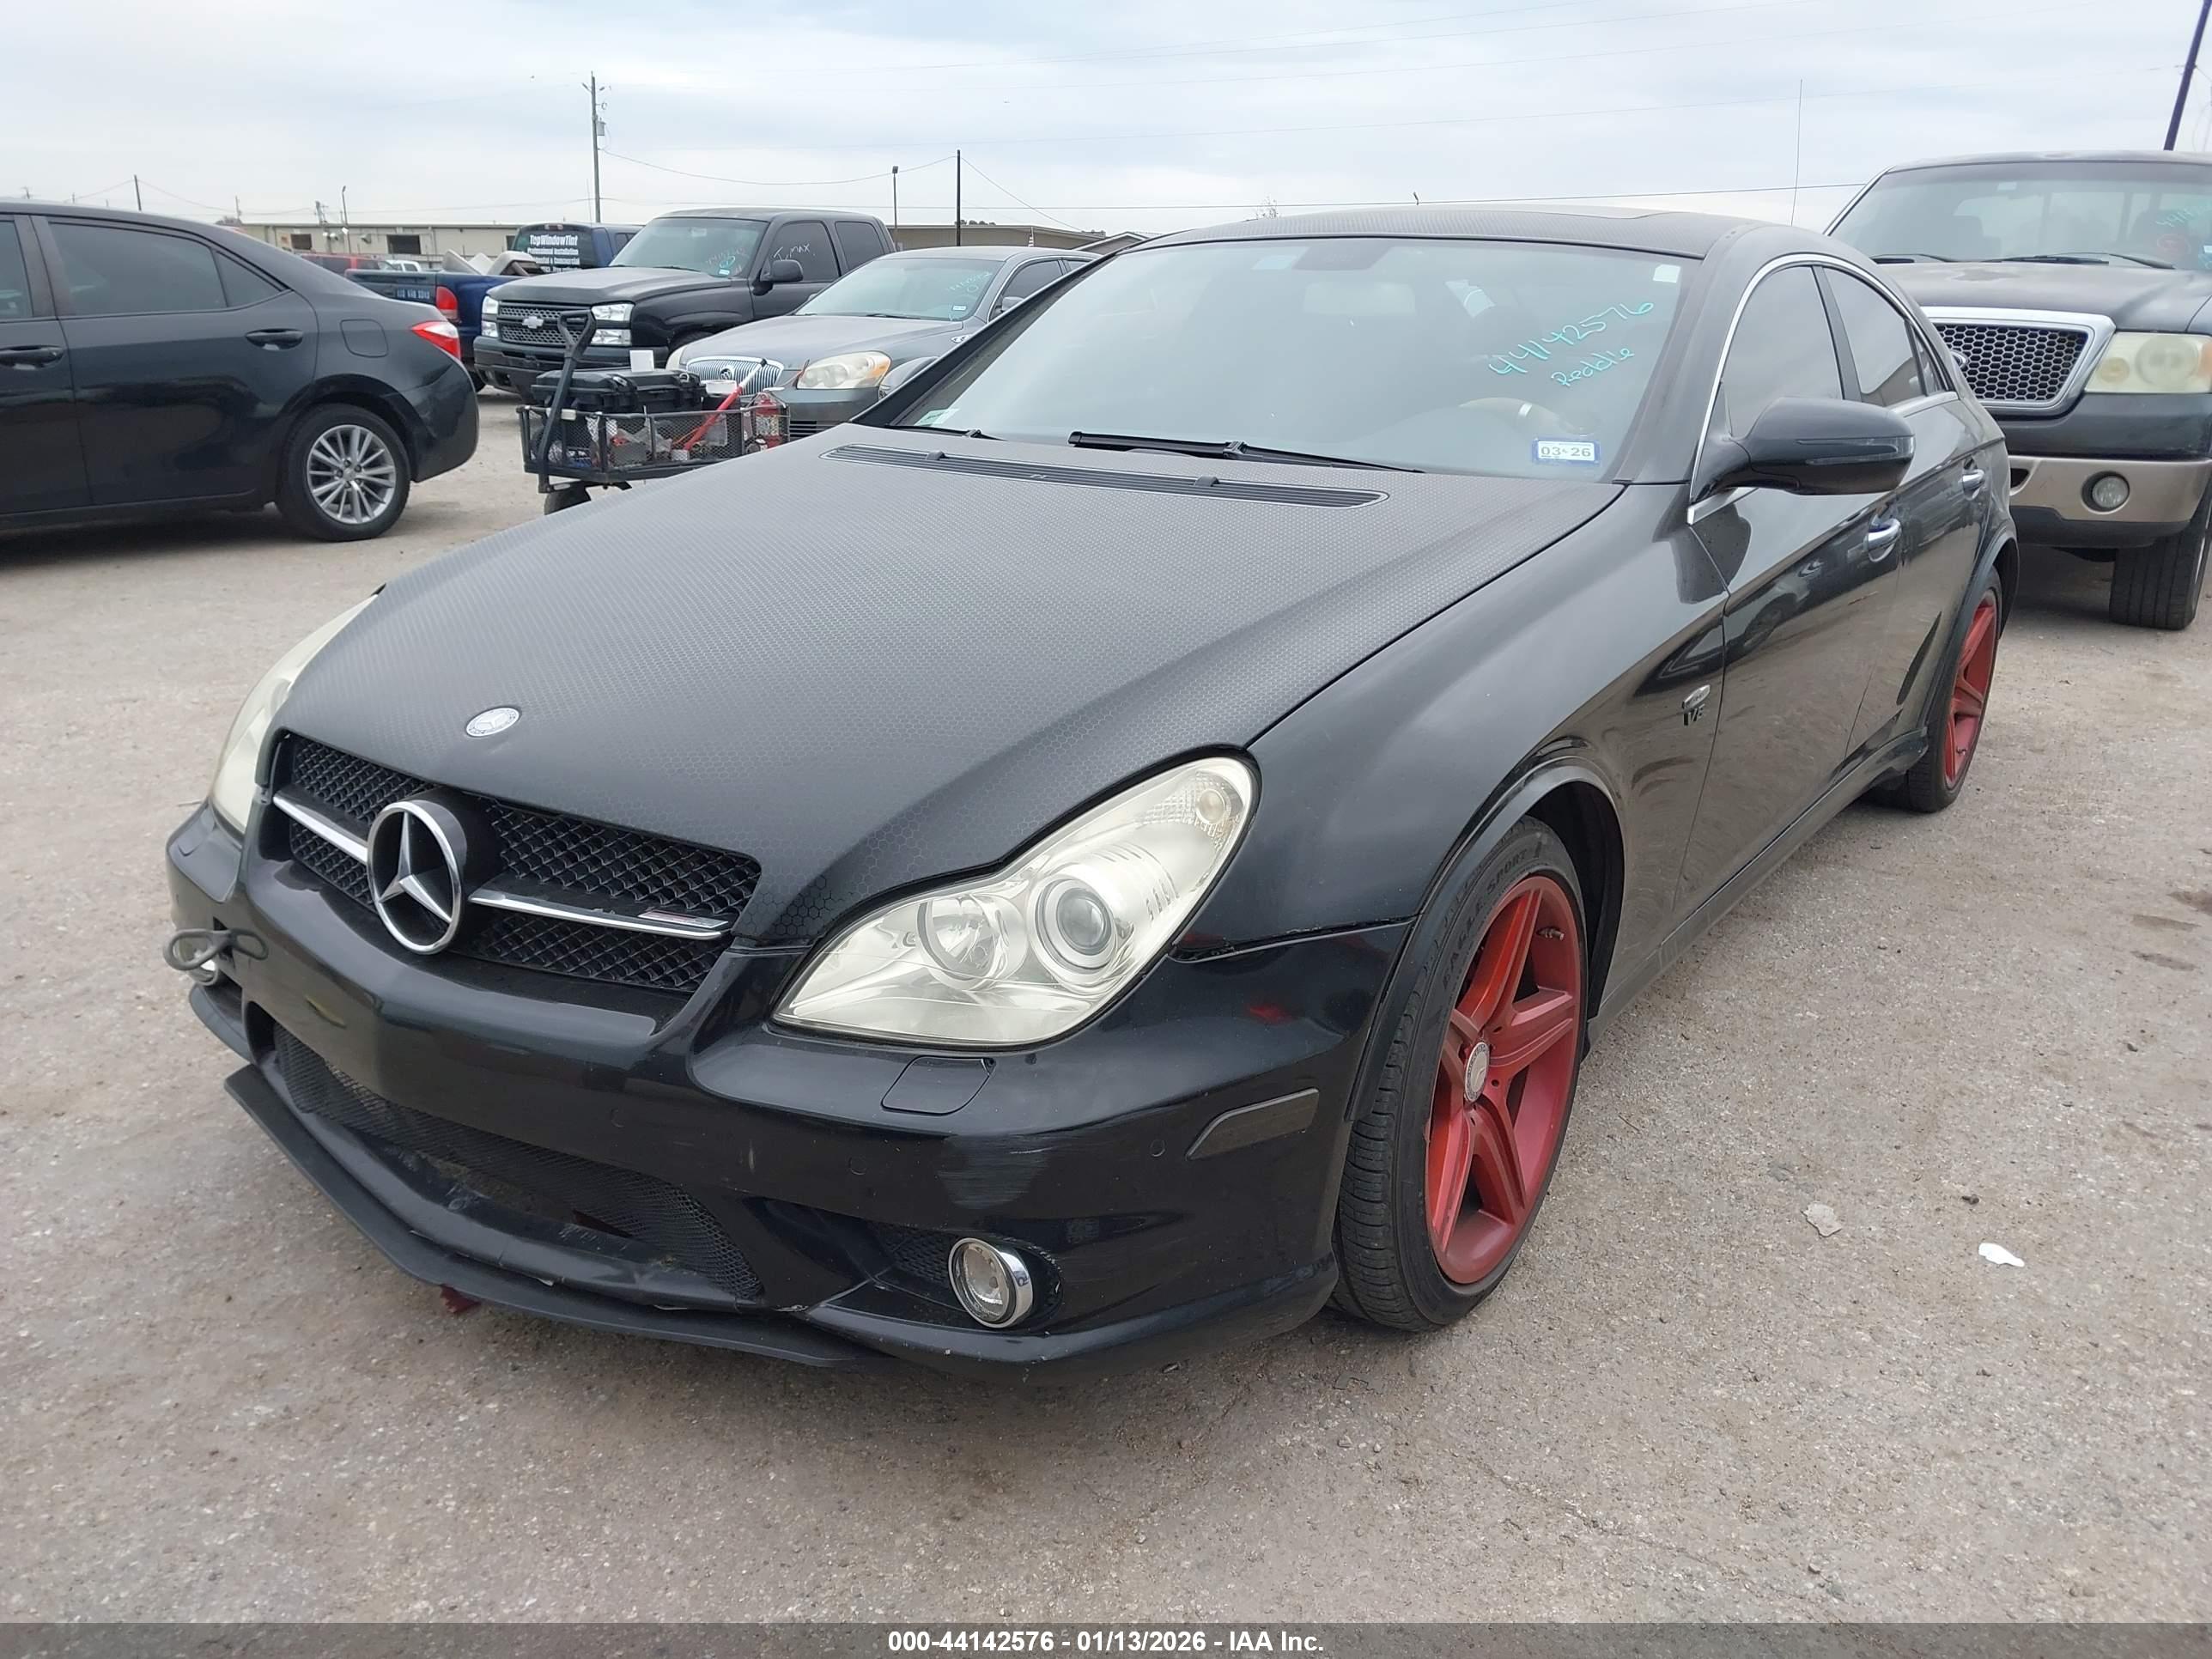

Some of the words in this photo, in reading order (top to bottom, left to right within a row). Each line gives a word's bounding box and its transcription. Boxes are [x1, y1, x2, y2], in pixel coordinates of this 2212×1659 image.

[1488, 302, 1654, 374] 44142576
[1540, 446, 1561, 456] 03
[1571, 447, 1591, 457] 26
[1486, 848, 1528, 896] SPORT
